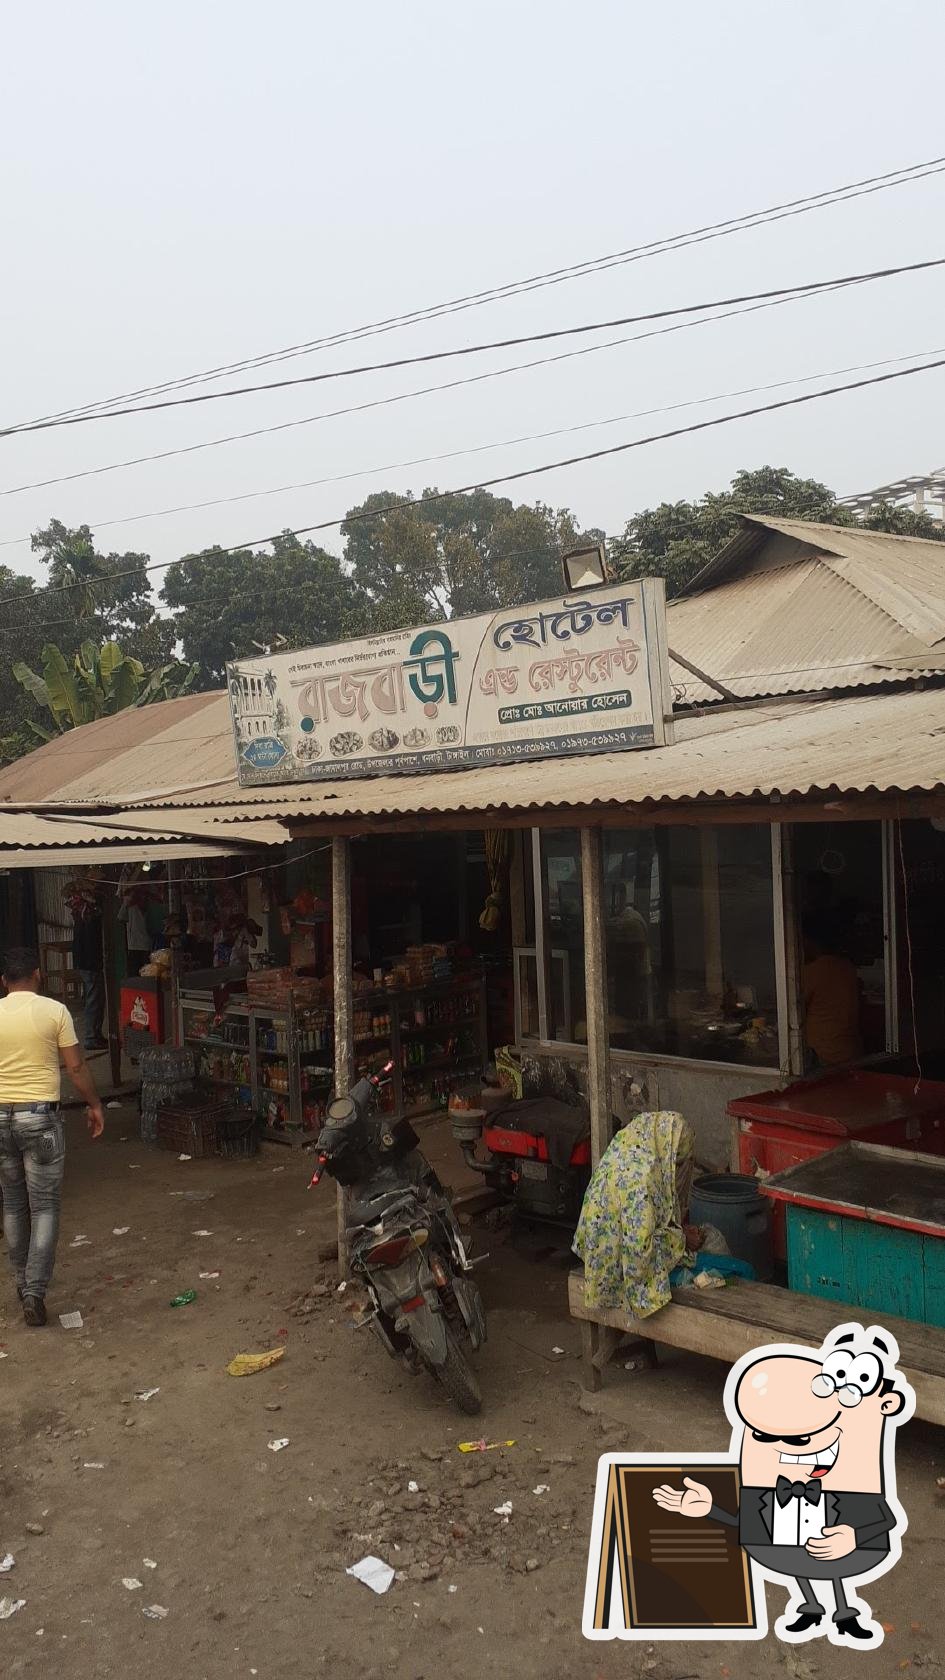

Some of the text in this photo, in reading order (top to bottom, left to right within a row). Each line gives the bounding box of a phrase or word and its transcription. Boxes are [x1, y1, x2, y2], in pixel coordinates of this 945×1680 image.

[494, 598, 635, 650] হোটেল
[290, 630, 460, 733] রাজবাড়ী
[528, 637, 640, 694] রেস্টুরেন্ট
[523, 703, 543, 717] মোঃ
[545, 696, 588, 714] আনোয়ার
[591, 693, 628, 710] হোসেন
